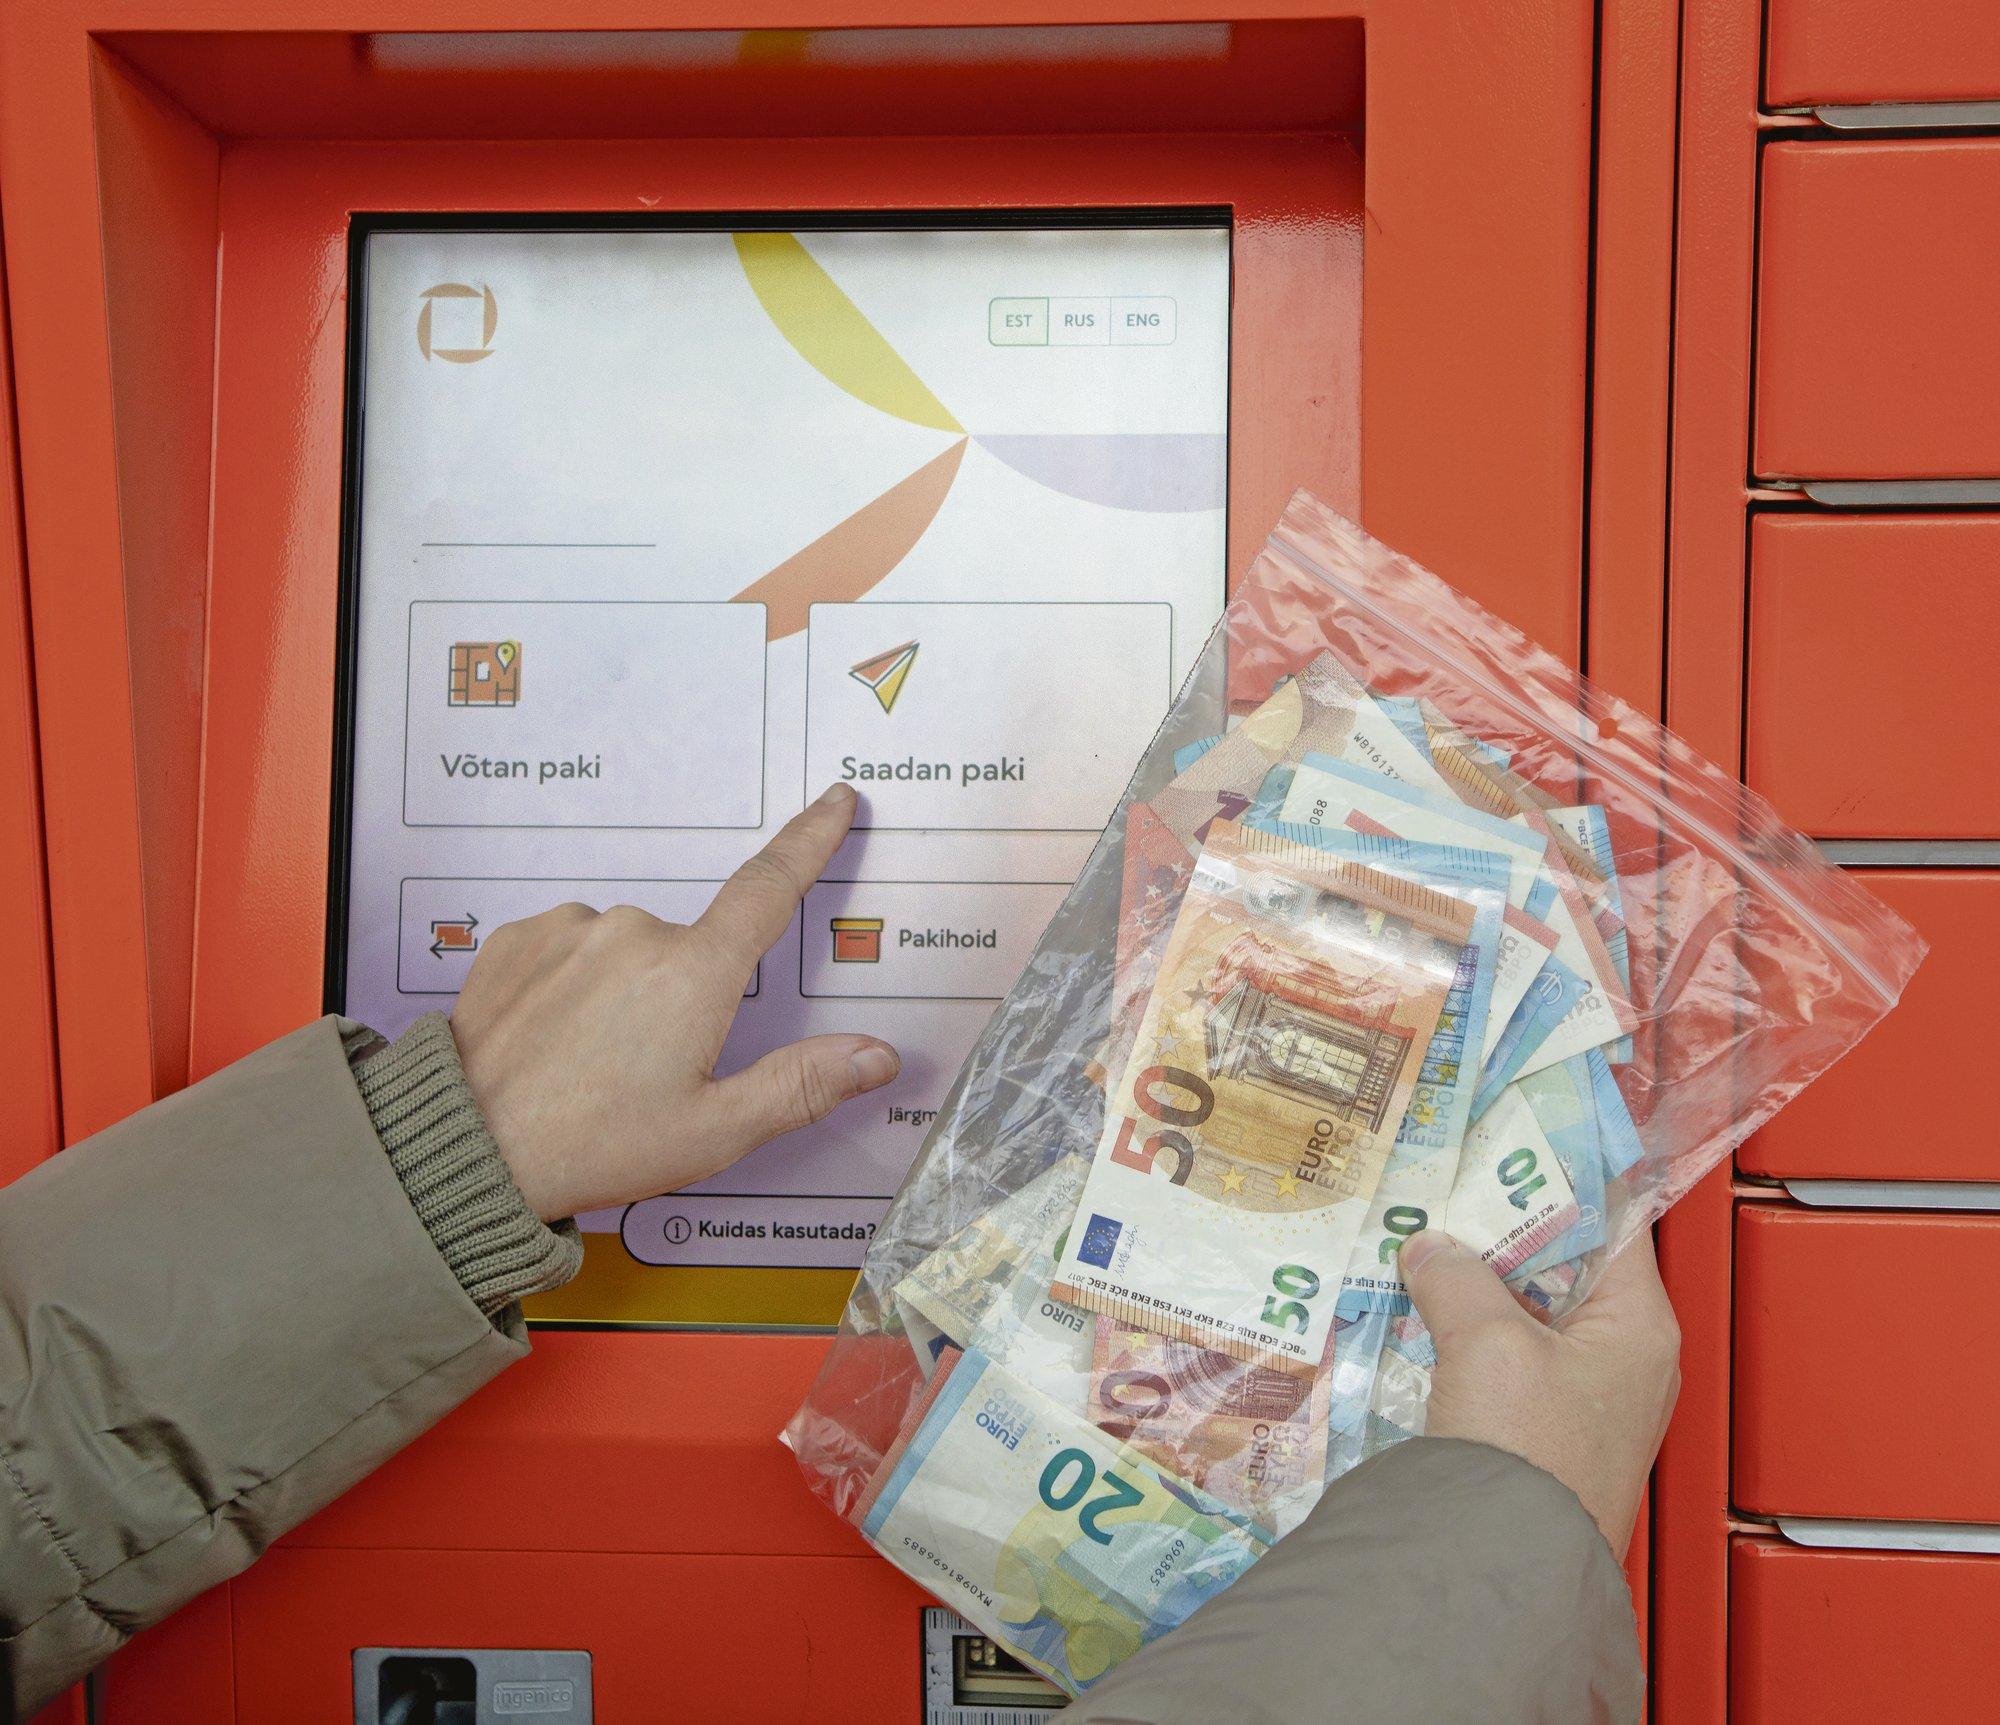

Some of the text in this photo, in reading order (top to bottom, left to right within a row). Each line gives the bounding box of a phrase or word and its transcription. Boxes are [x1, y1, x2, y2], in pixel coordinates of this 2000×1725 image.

[1005, 313, 1160, 327] EST RUS ENG
[440, 753, 600, 785] Võtan paki
[841, 756, 1025, 787] Saadan paki
[900, 928, 997, 949] Pakihoid
[1109, 1066, 1215, 1187] 50
[1295, 1118, 1335, 1183] EURO
[1497, 1148, 1548, 1211] 10
[698, 1220, 877, 1241] Kuidas kasutada?
[1067, 1272, 1086, 1282] 2017
[1087, 1276, 1108, 1290] EBC
[1130, 1291, 1151, 1304] EKB
[1152, 1299, 1172, 1312] ESB
[1260, 1263, 1321, 1336] 50
[1040, 1303, 1085, 1333] EURO
[1194, 1313, 1215, 1327] EKP
[1216, 1319, 1236, 1332] EZB
[1259, 1333, 1279, 1347] ECB
[975, 1412, 1019, 1451] EURO
[1248, 1423, 1270, 1484] EURO
[1038, 1448, 1145, 1546] 20
[902, 1536, 993, 1607] MX0981696885
[496, 1686, 571, 1708] ingenico
